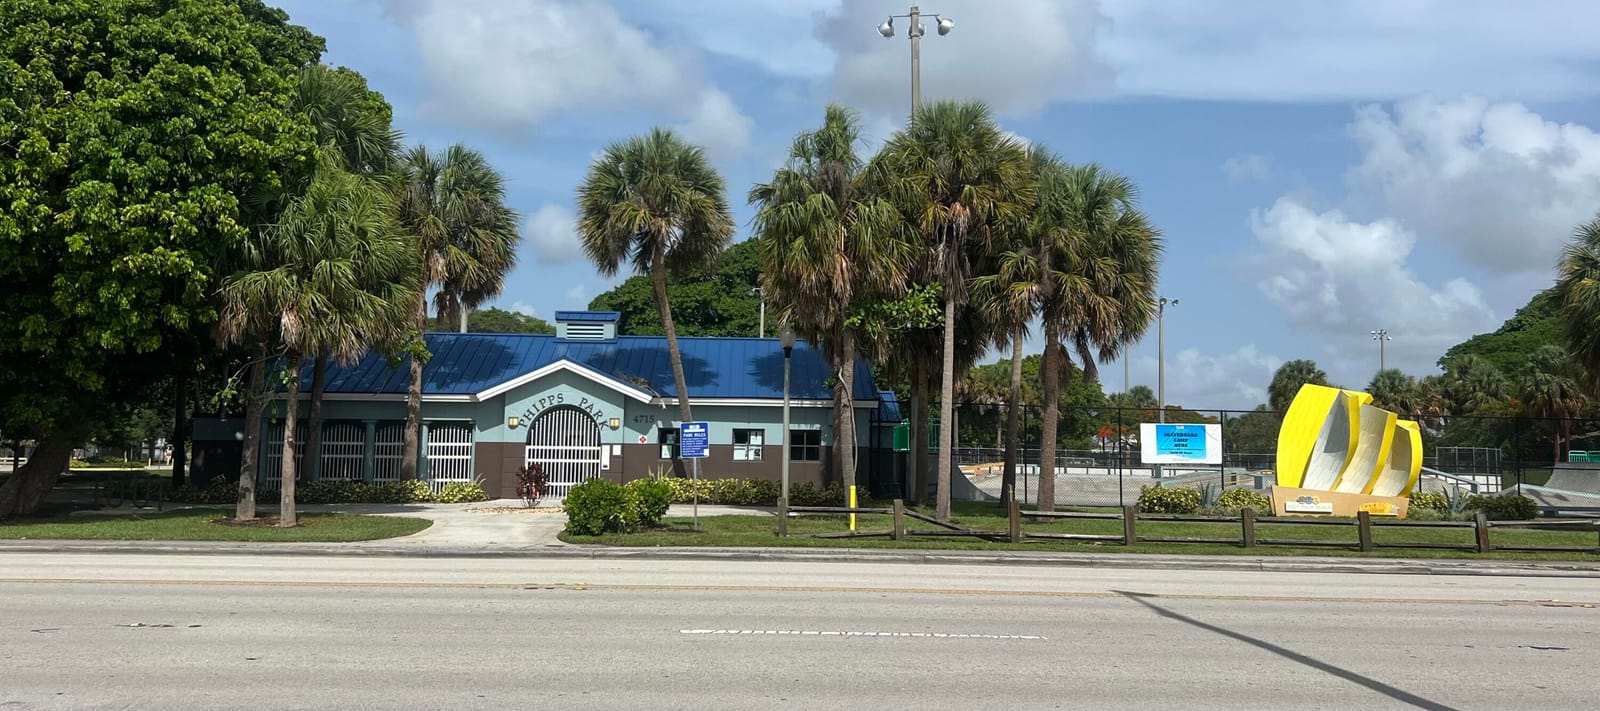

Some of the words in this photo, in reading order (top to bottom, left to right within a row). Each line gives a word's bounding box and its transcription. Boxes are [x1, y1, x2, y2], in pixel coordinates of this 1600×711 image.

[519, 393, 564, 428] PHIPPS
[578, 397, 609, 430] PARK
[633, 415, 655, 424] 4715
